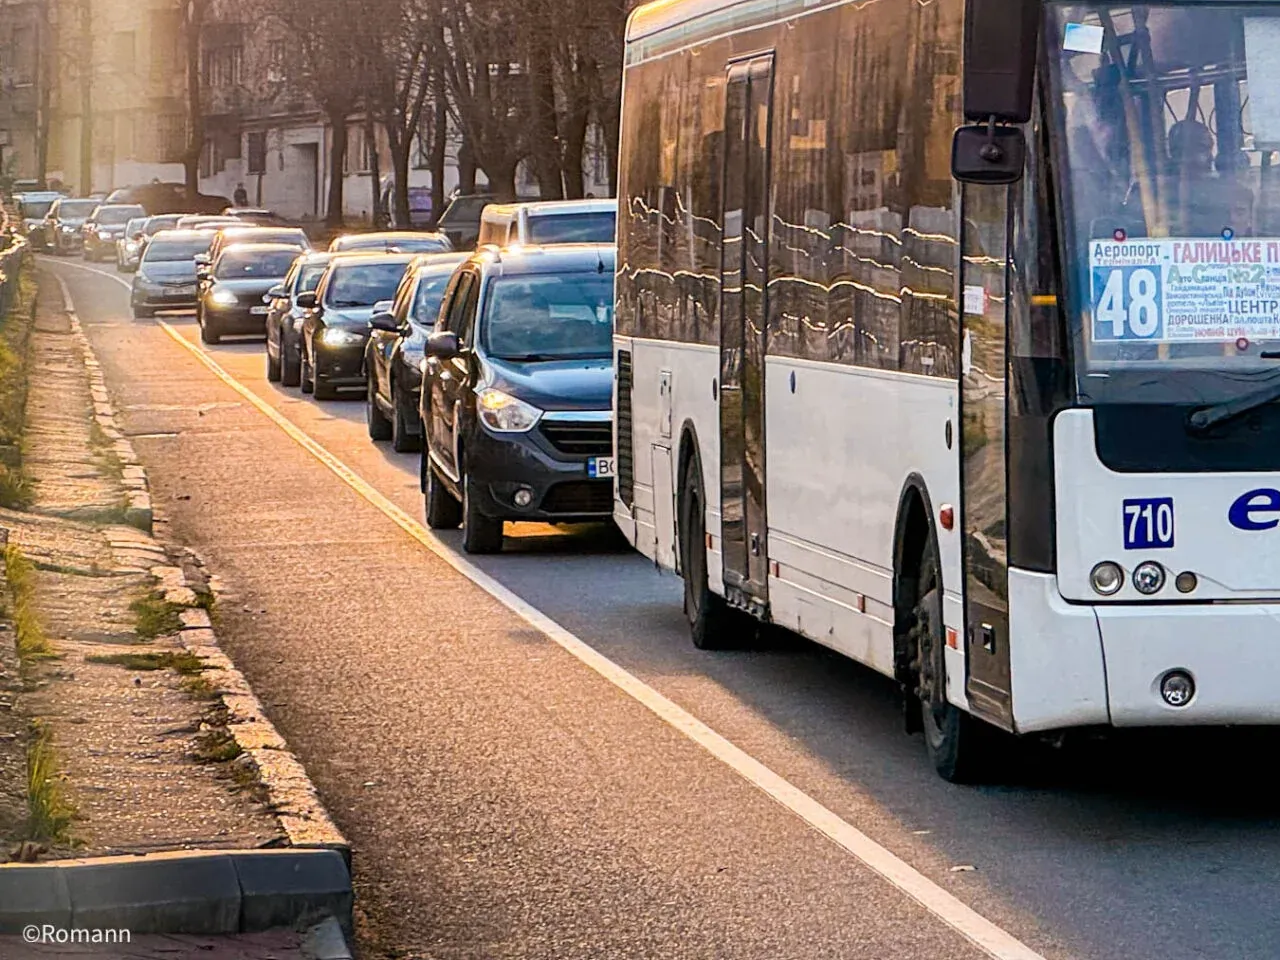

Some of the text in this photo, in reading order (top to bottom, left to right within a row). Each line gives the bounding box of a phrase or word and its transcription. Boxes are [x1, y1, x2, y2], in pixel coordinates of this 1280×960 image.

[1094, 243, 1160, 259] Аеропорт
[1173, 242, 1261, 264] ГАЛИЦЬКЕ
[1096, 269, 1158, 337] 48
[1228, 300, 1278, 315] ЦЕНТР
[1168, 314, 1228, 325] ДОРОШЕНКА
[1125, 493, 1172, 543] 710
